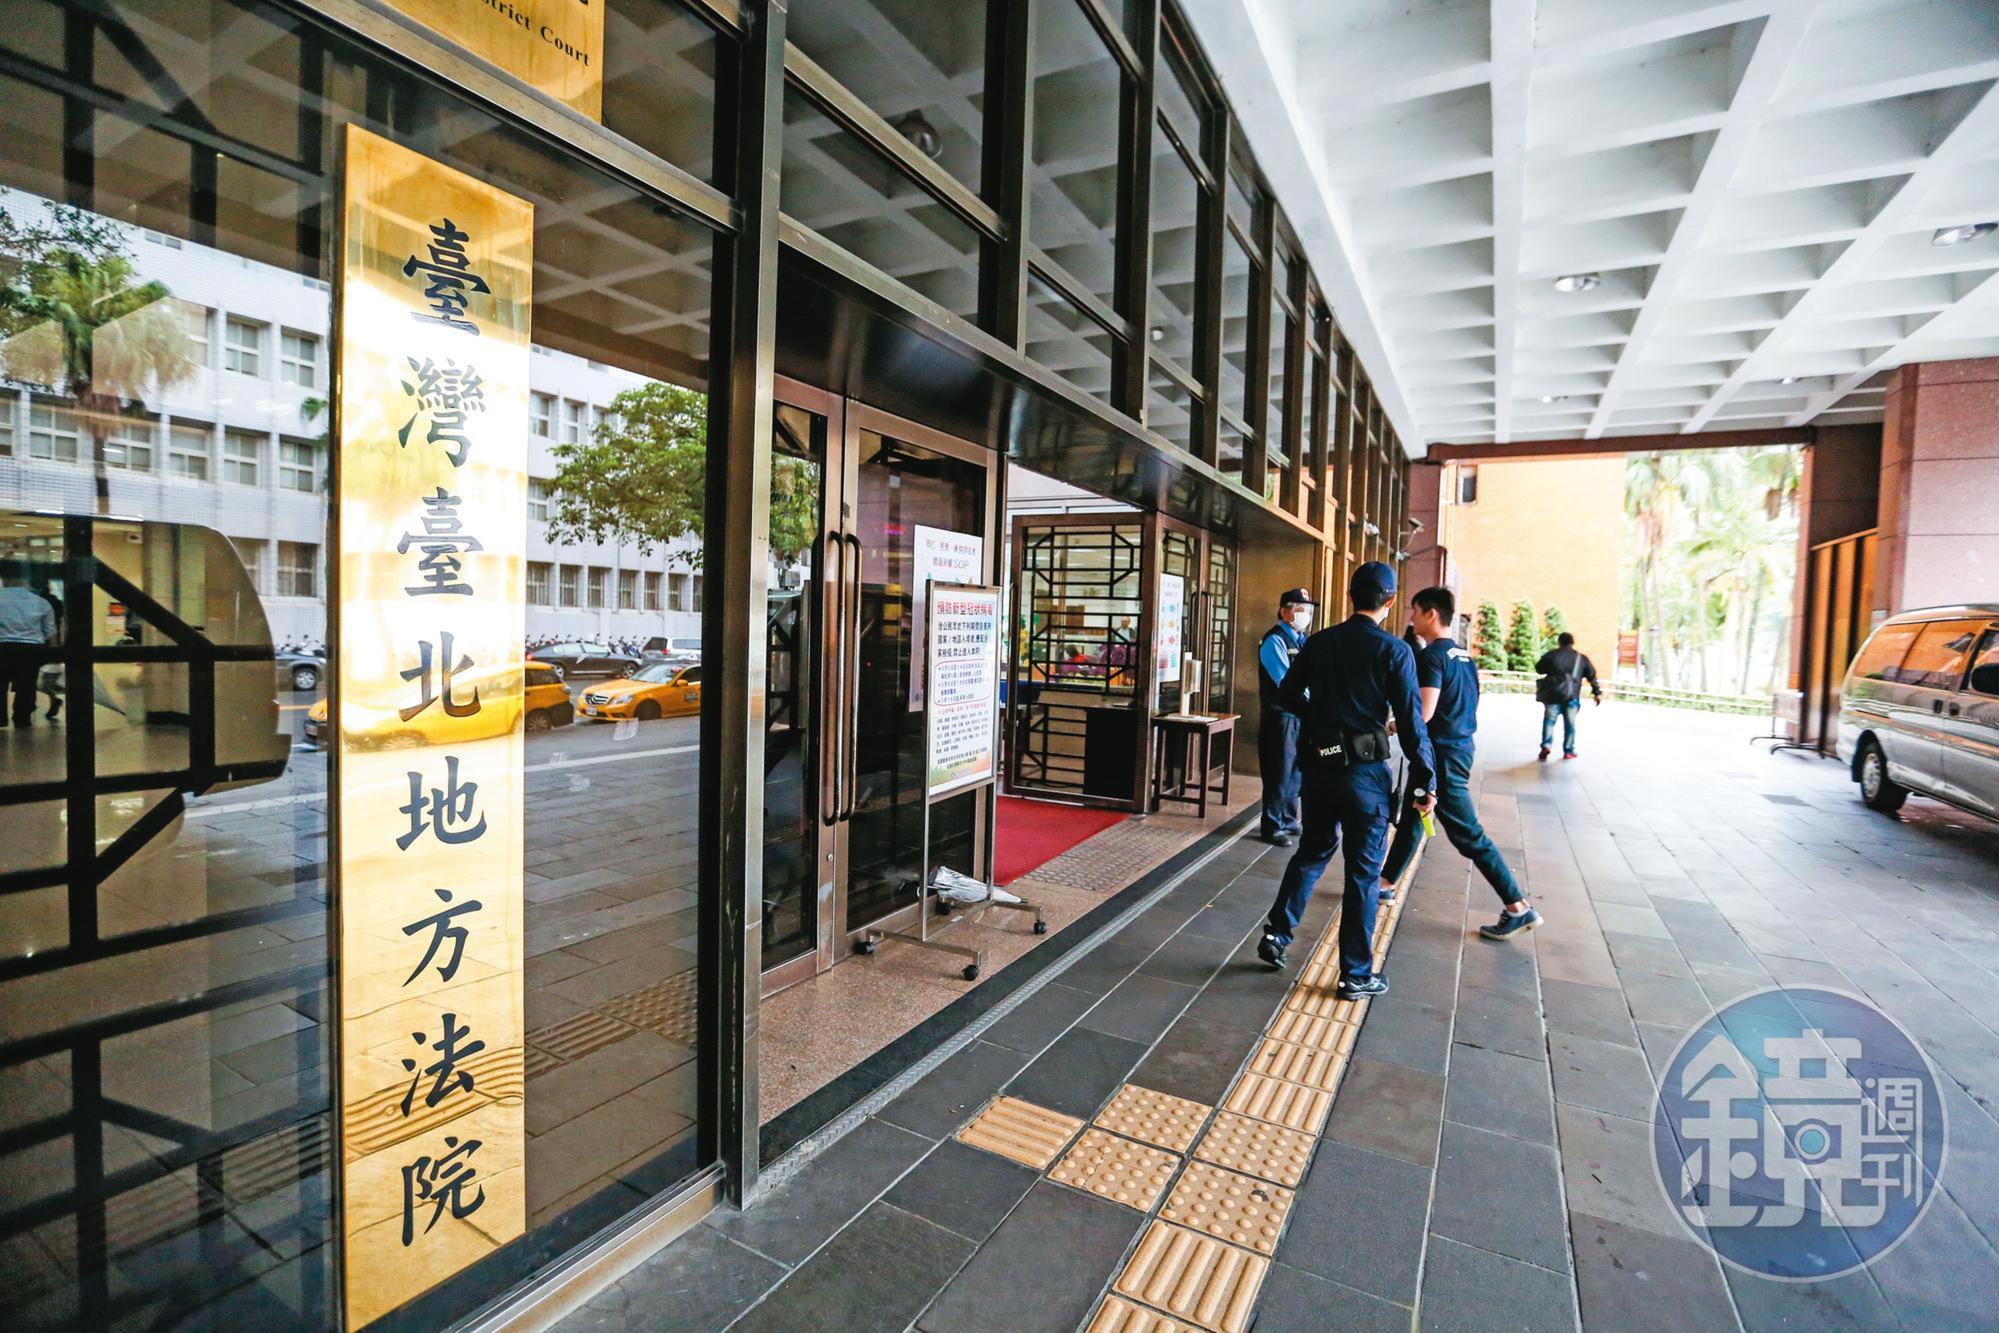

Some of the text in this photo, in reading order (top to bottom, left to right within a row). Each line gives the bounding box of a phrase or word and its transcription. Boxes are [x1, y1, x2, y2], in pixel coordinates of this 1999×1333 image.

[540, 26, 590, 67] Court
[396, 217, 491, 1247] 臺灣臺北地方法院
[1319, 744, 1342, 757] POLICE
